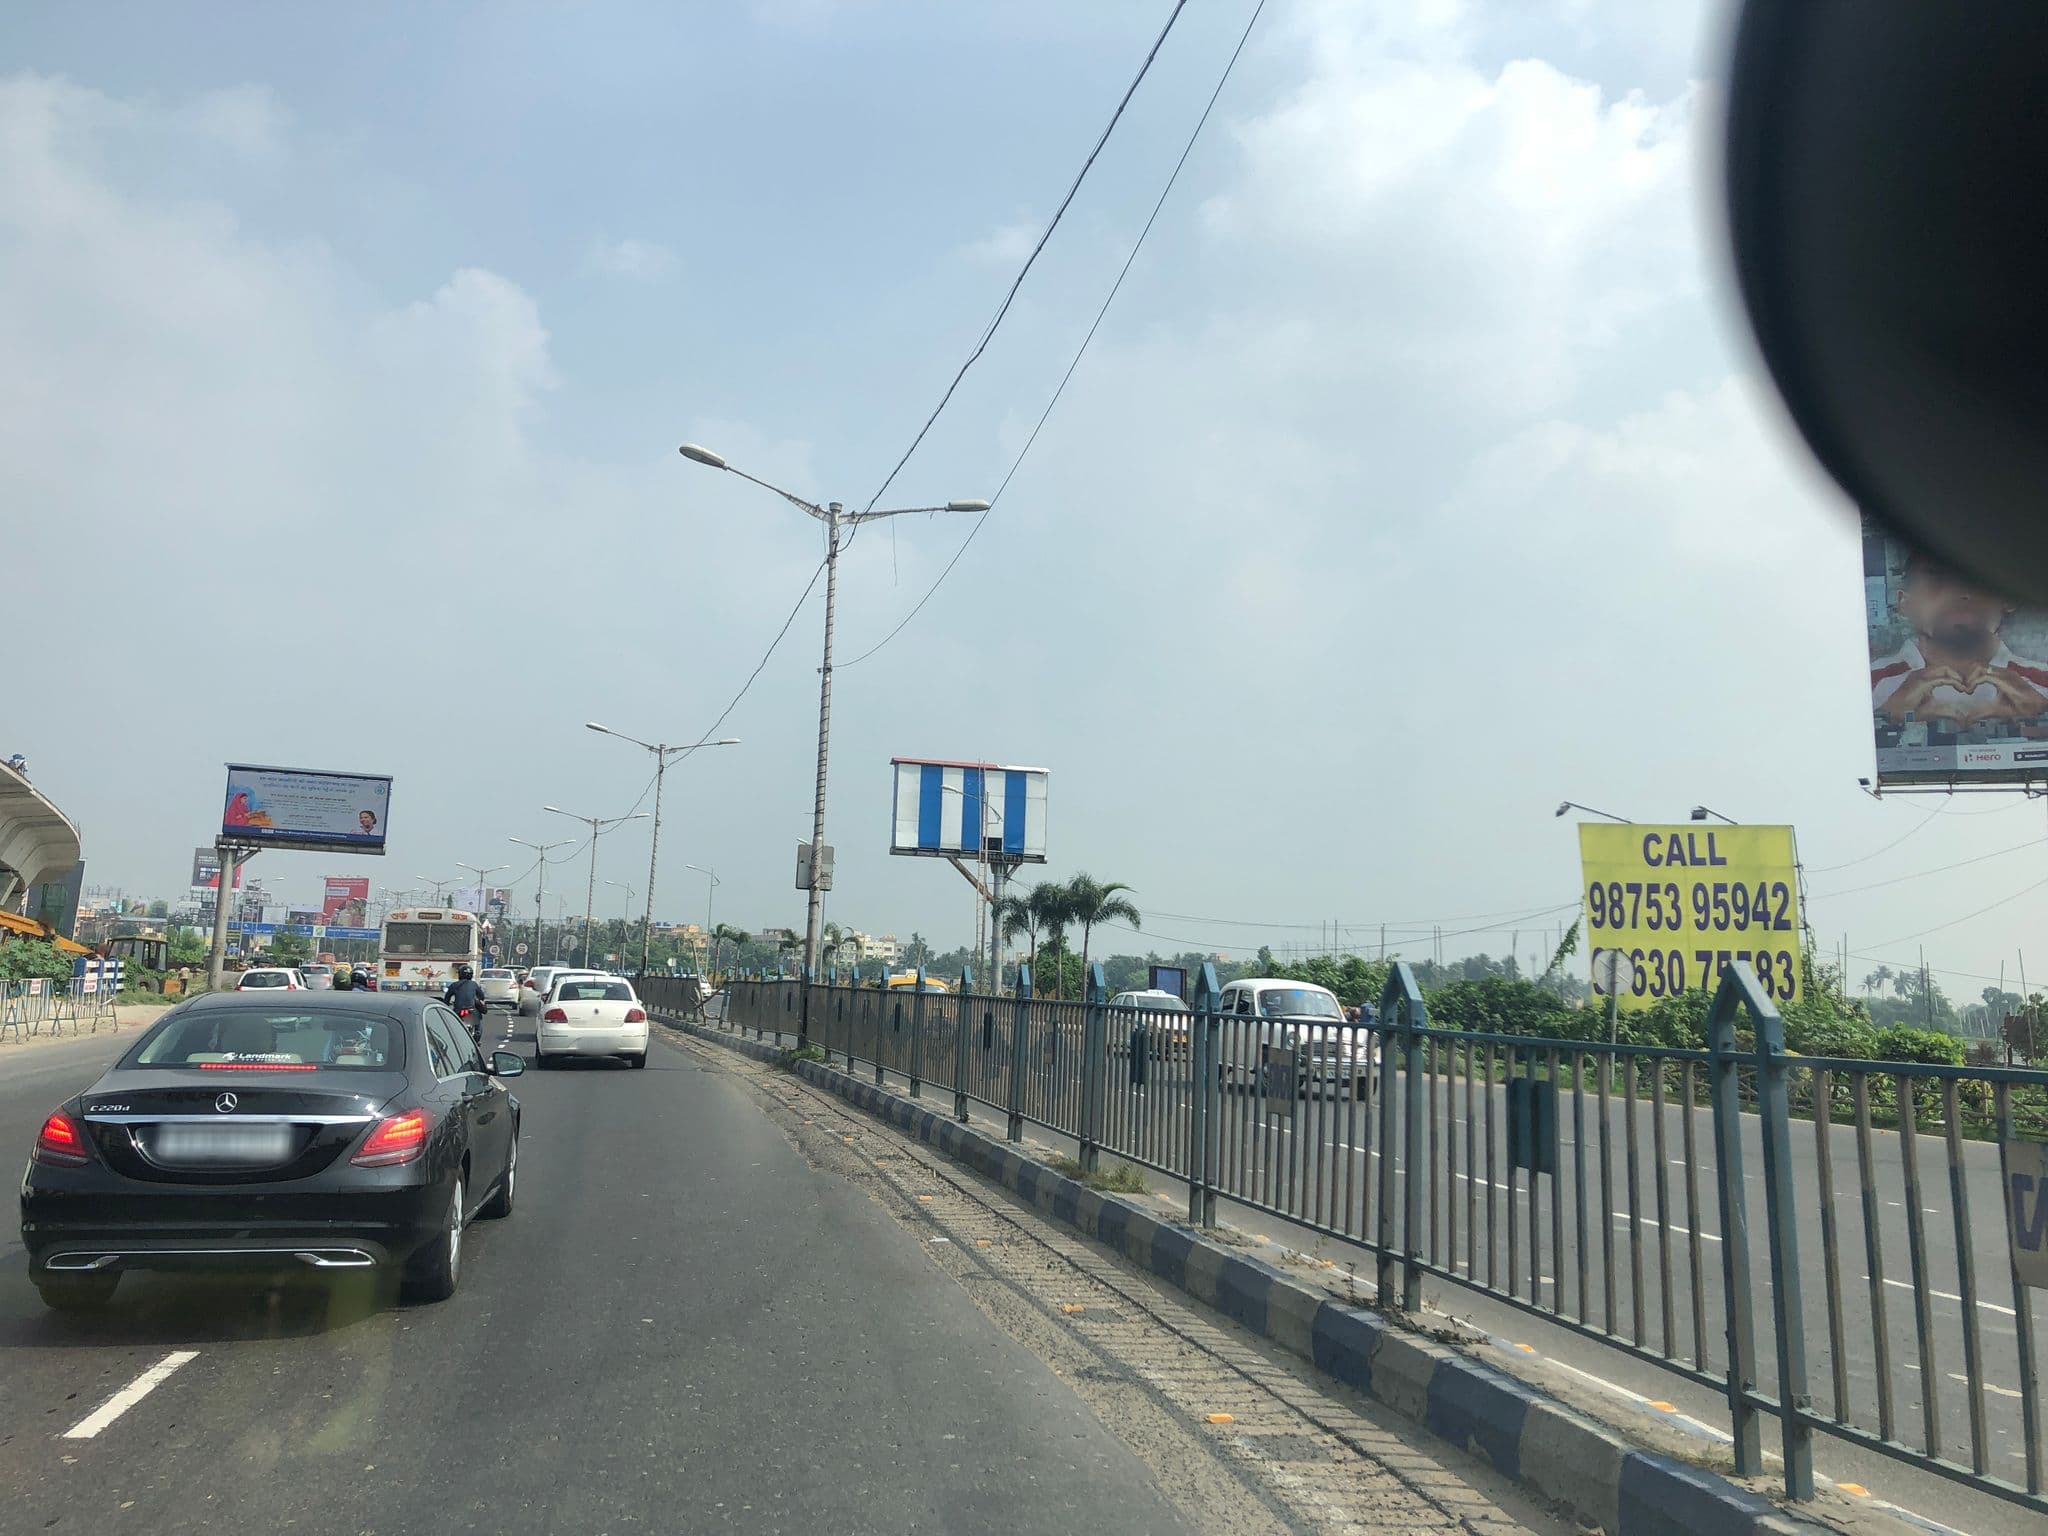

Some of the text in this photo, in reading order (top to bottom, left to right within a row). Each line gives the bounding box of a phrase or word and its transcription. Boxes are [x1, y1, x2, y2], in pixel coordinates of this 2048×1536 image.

[1643, 832, 1727, 867] CALL
[1589, 881, 1792, 931] 98753 95942
[1592, 947, 1796, 1001] 630 7583
[239, 1052, 291, 1060] Landmark
